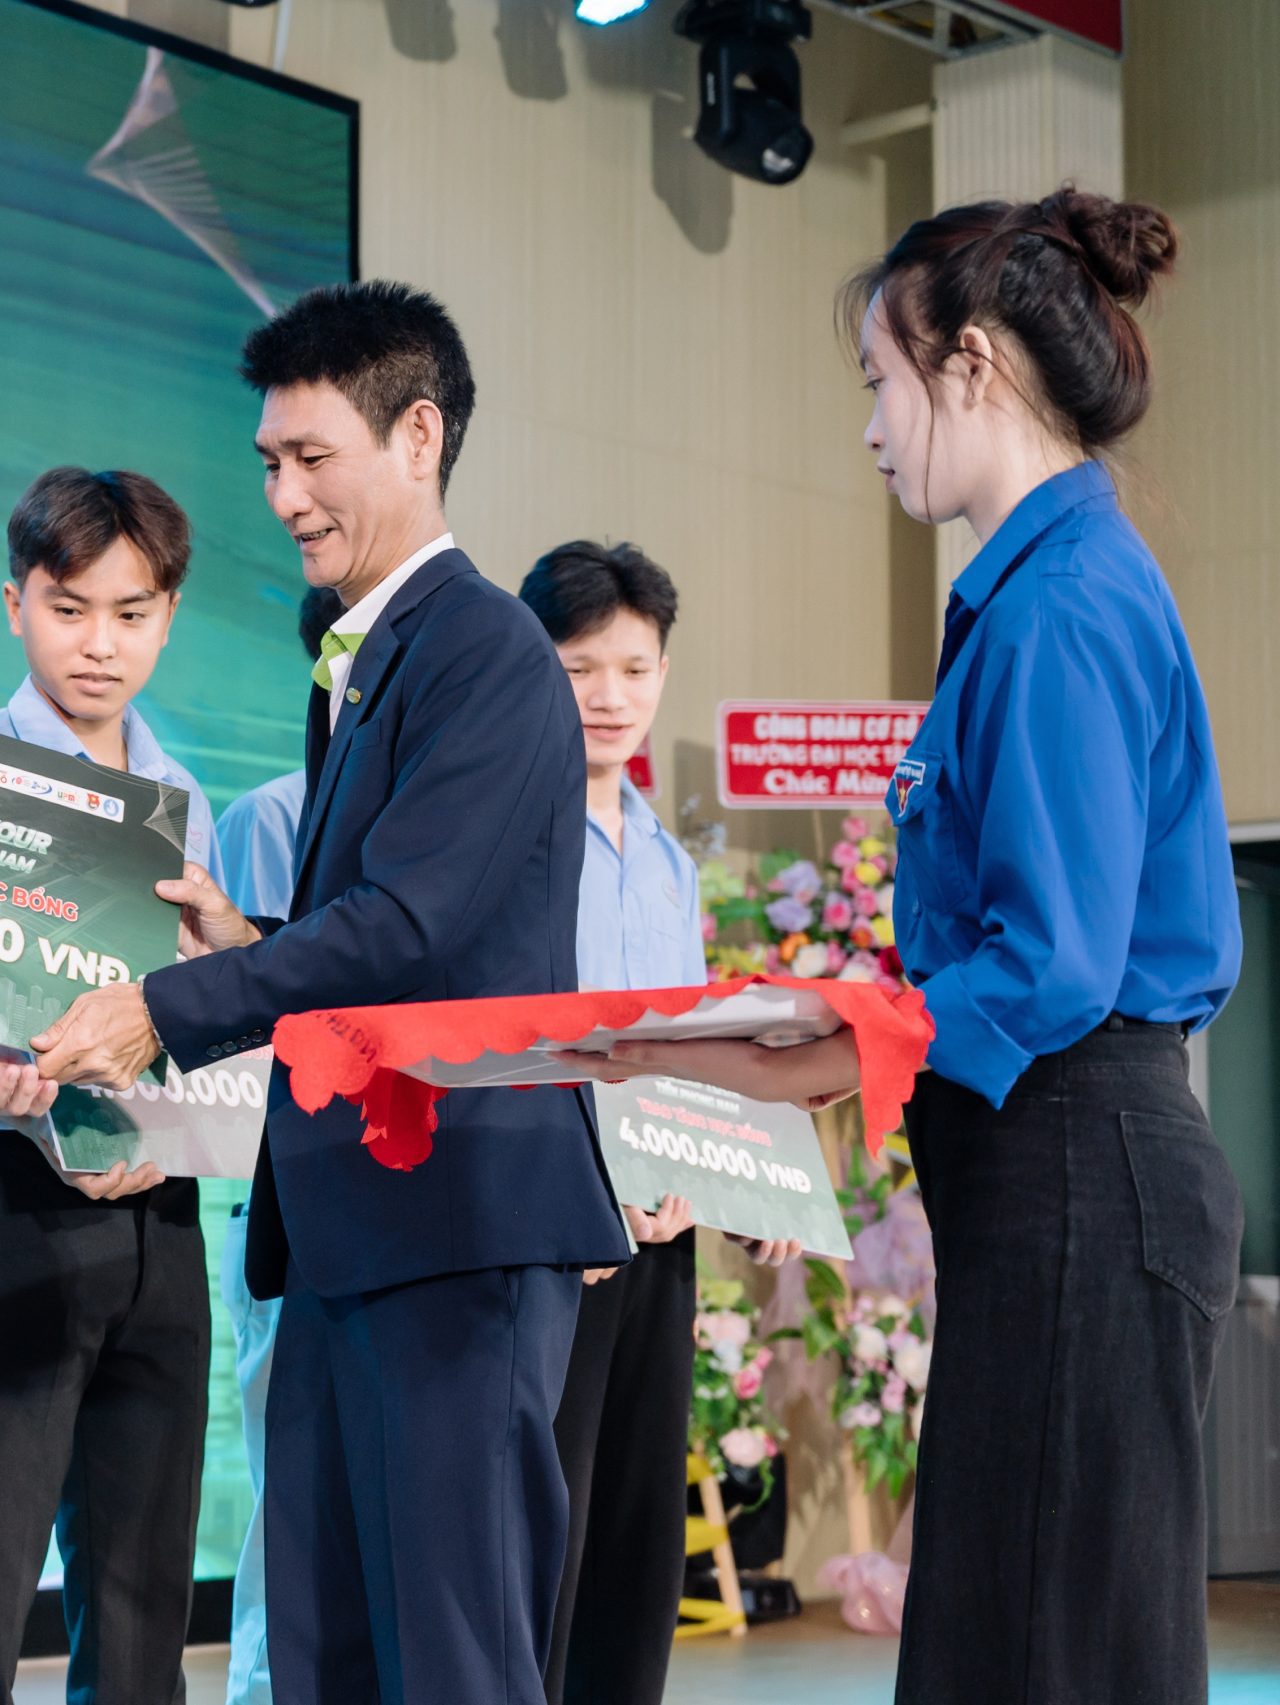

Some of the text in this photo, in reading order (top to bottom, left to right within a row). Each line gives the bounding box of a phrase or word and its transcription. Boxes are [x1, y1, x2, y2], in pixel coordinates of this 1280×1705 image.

[883, 741, 908, 766] TÂ
[764, 768, 830, 795] Chúc
[835, 769, 890, 795] Mừn
[11, 886, 79, 923] BỔNG
[37, 936, 131, 988] VNĐ
[618, 1115, 813, 1195] 4.000.000 VNĐ
